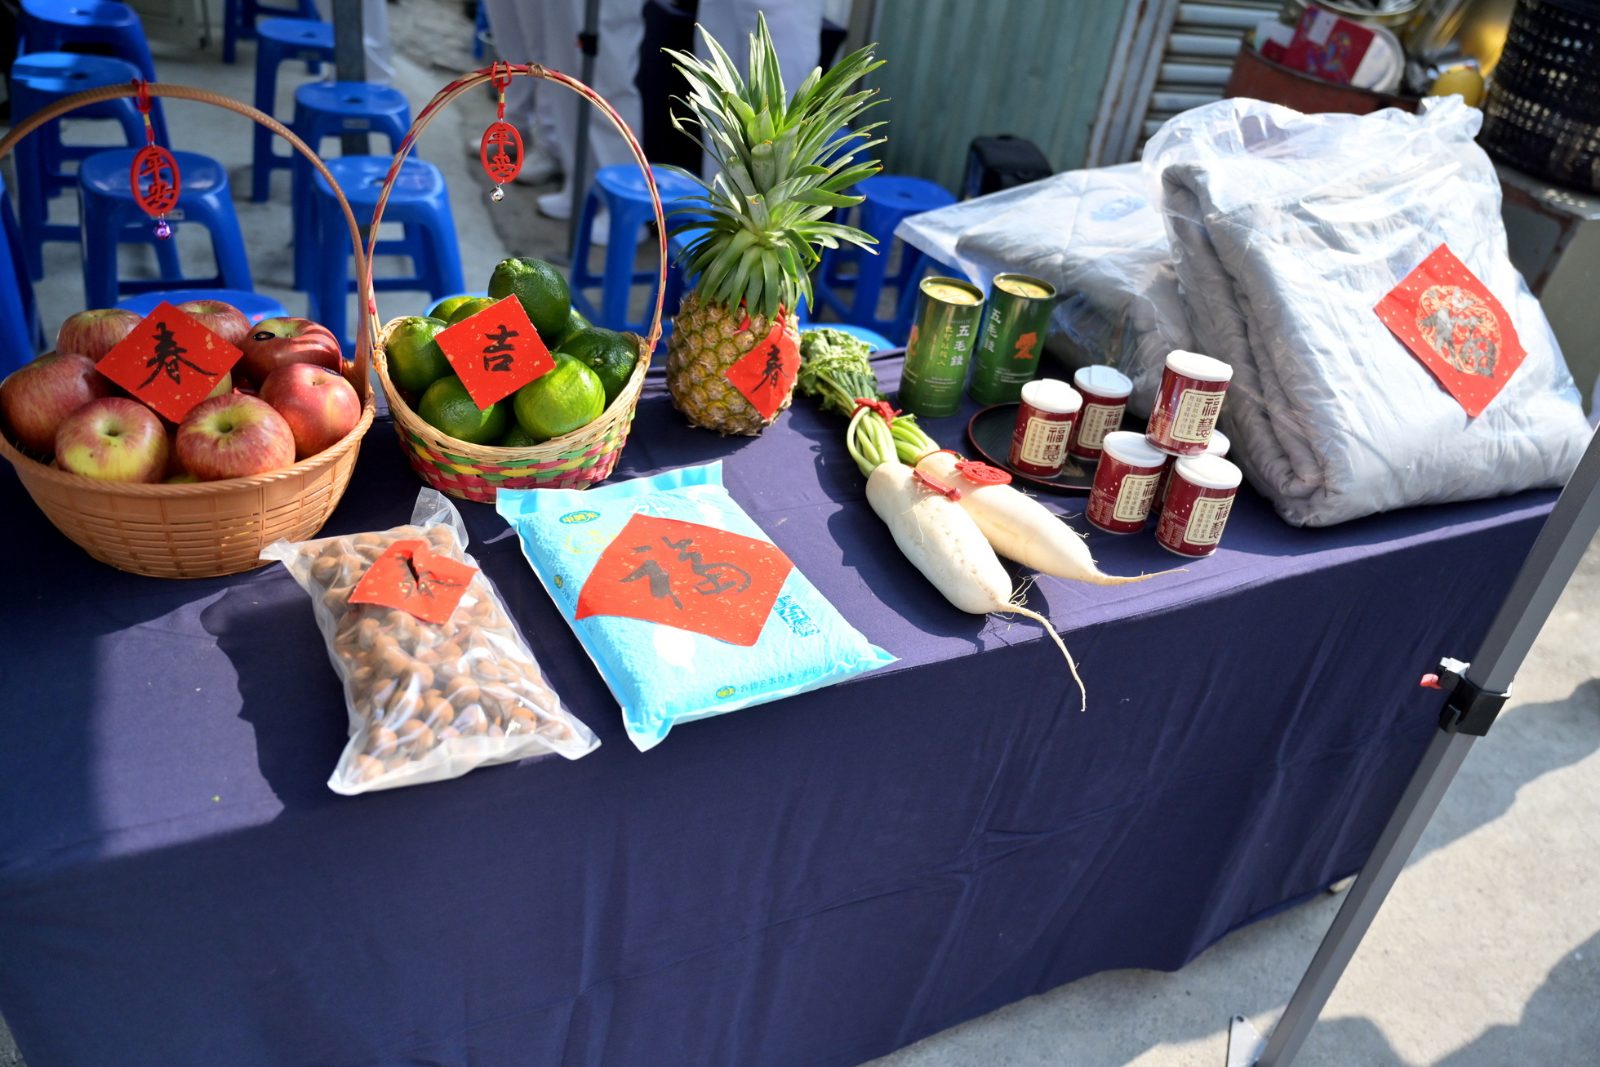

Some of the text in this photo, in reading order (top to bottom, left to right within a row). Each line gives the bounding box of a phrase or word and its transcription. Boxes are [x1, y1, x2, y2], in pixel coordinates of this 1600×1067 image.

[139, 150, 177, 208] 平安
[487, 127, 517, 178] 平安
[137, 321, 219, 391] 春
[483, 324, 519, 372] 吉
[751, 343, 789, 394] 春
[619, 535, 753, 611] 福
